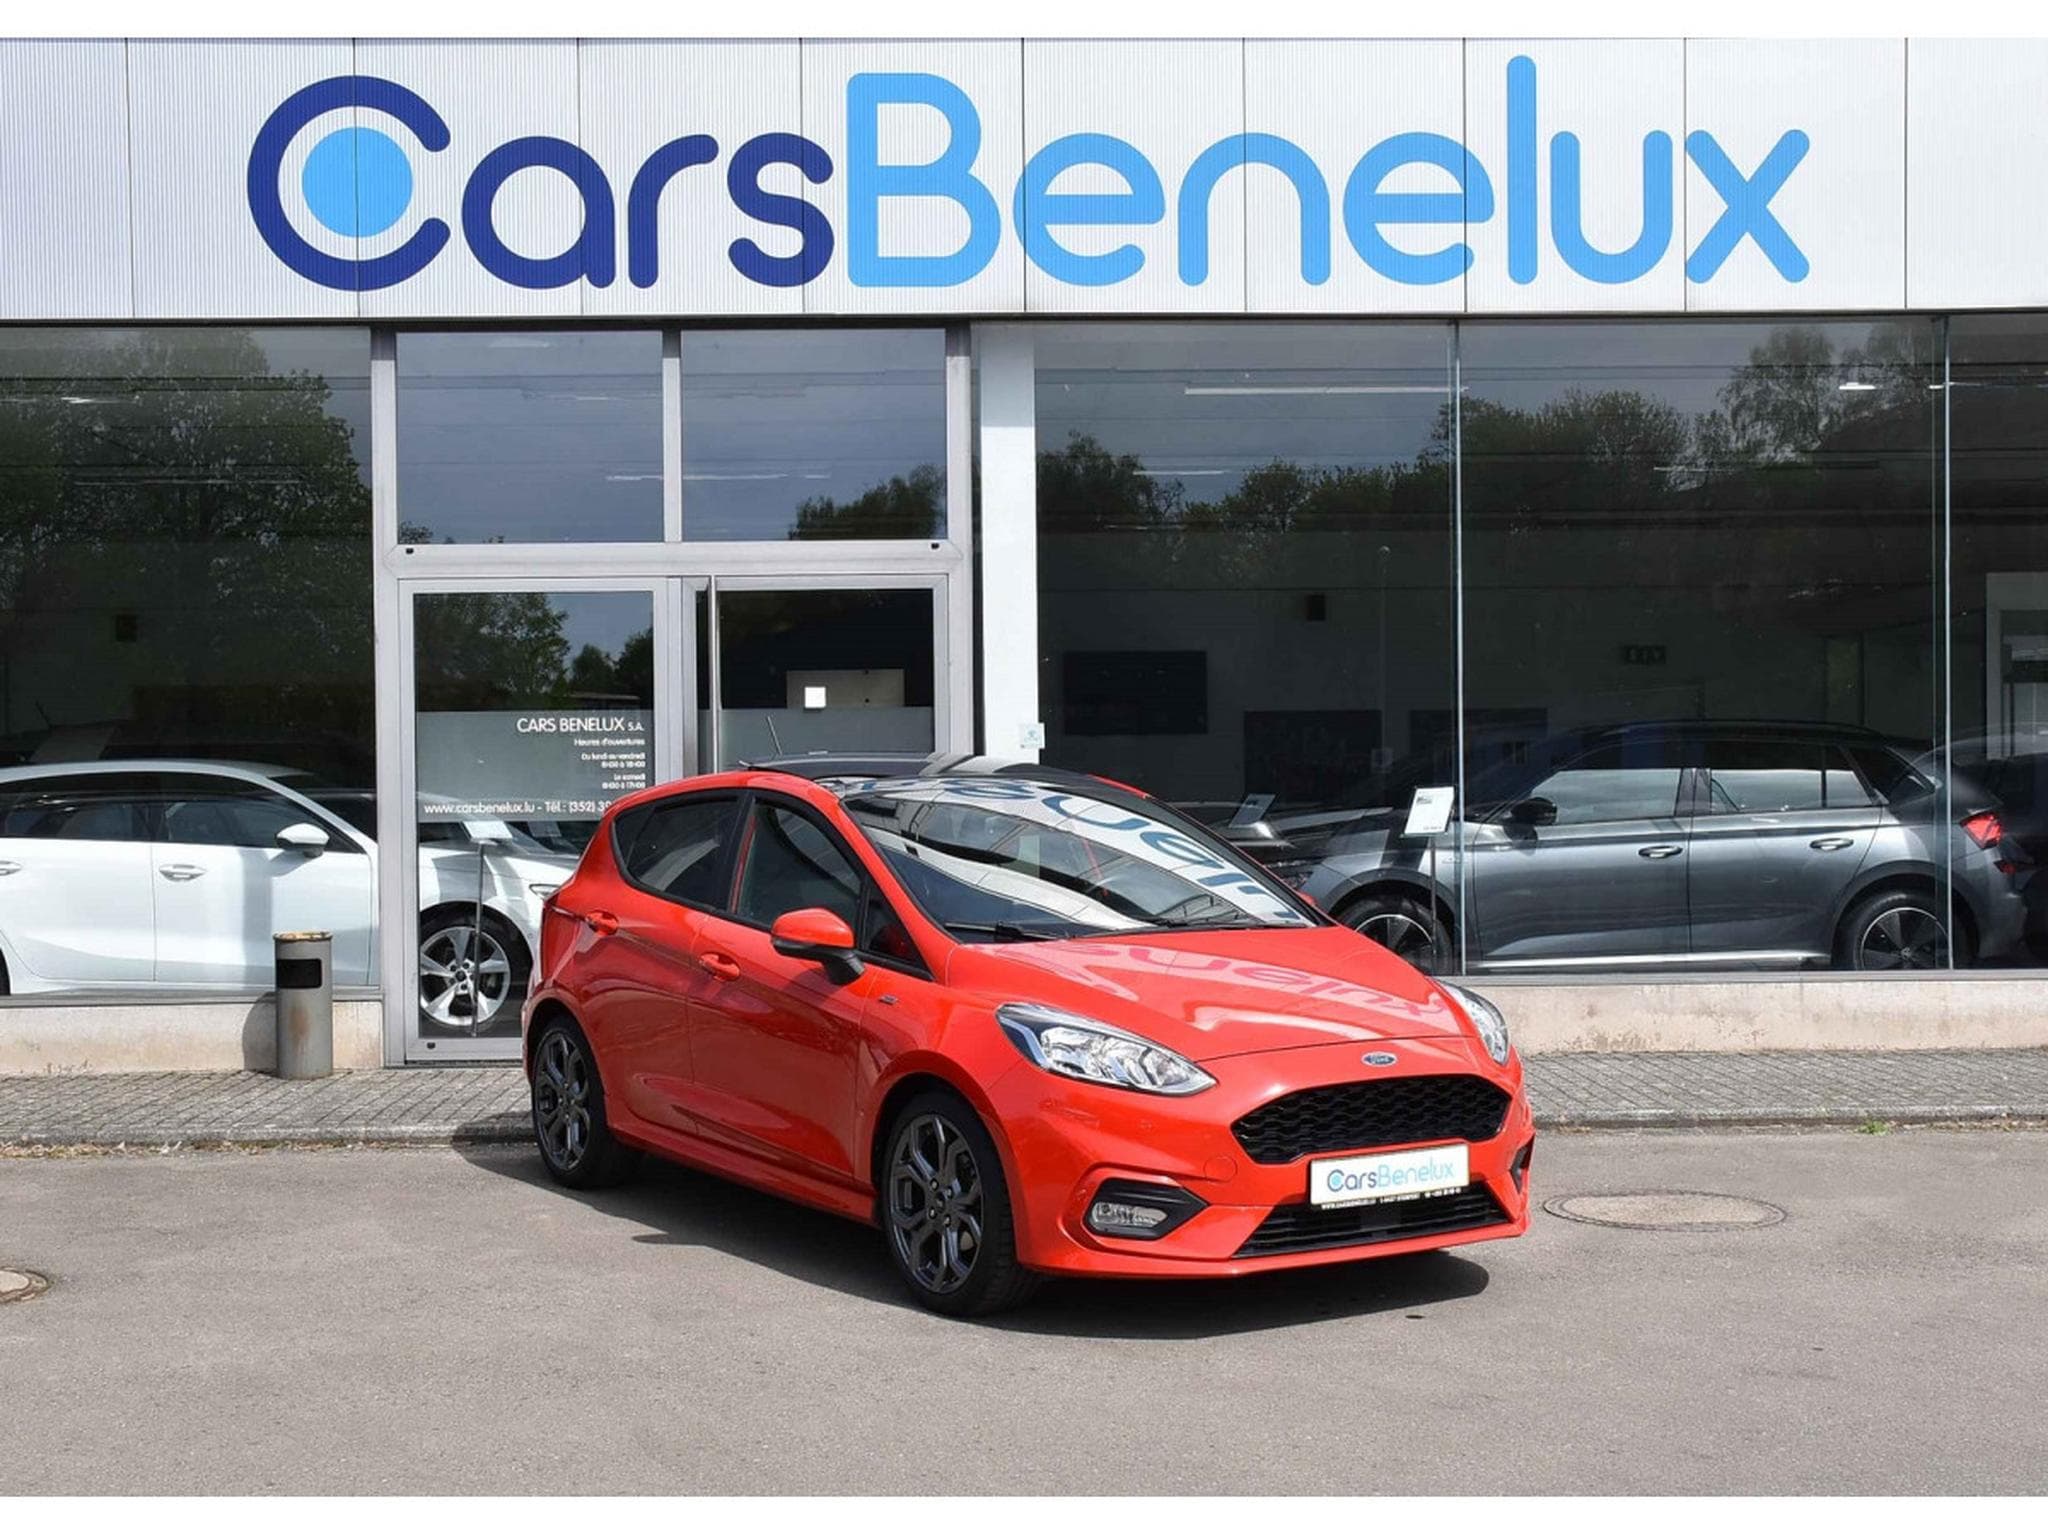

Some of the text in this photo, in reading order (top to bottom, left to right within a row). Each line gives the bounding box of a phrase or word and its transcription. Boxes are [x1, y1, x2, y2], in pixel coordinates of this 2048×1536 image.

[247, 55, 1811, 291] CarsBenelux
[516, 717, 557, 733] CARS
[559, 717, 625, 733] BENELUX
[424, 801, 535, 815] www.carsbenelux.lu
[568, 801, 595, 814] (352)
[1326, 1157, 1456, 1193] CarsBenelux
